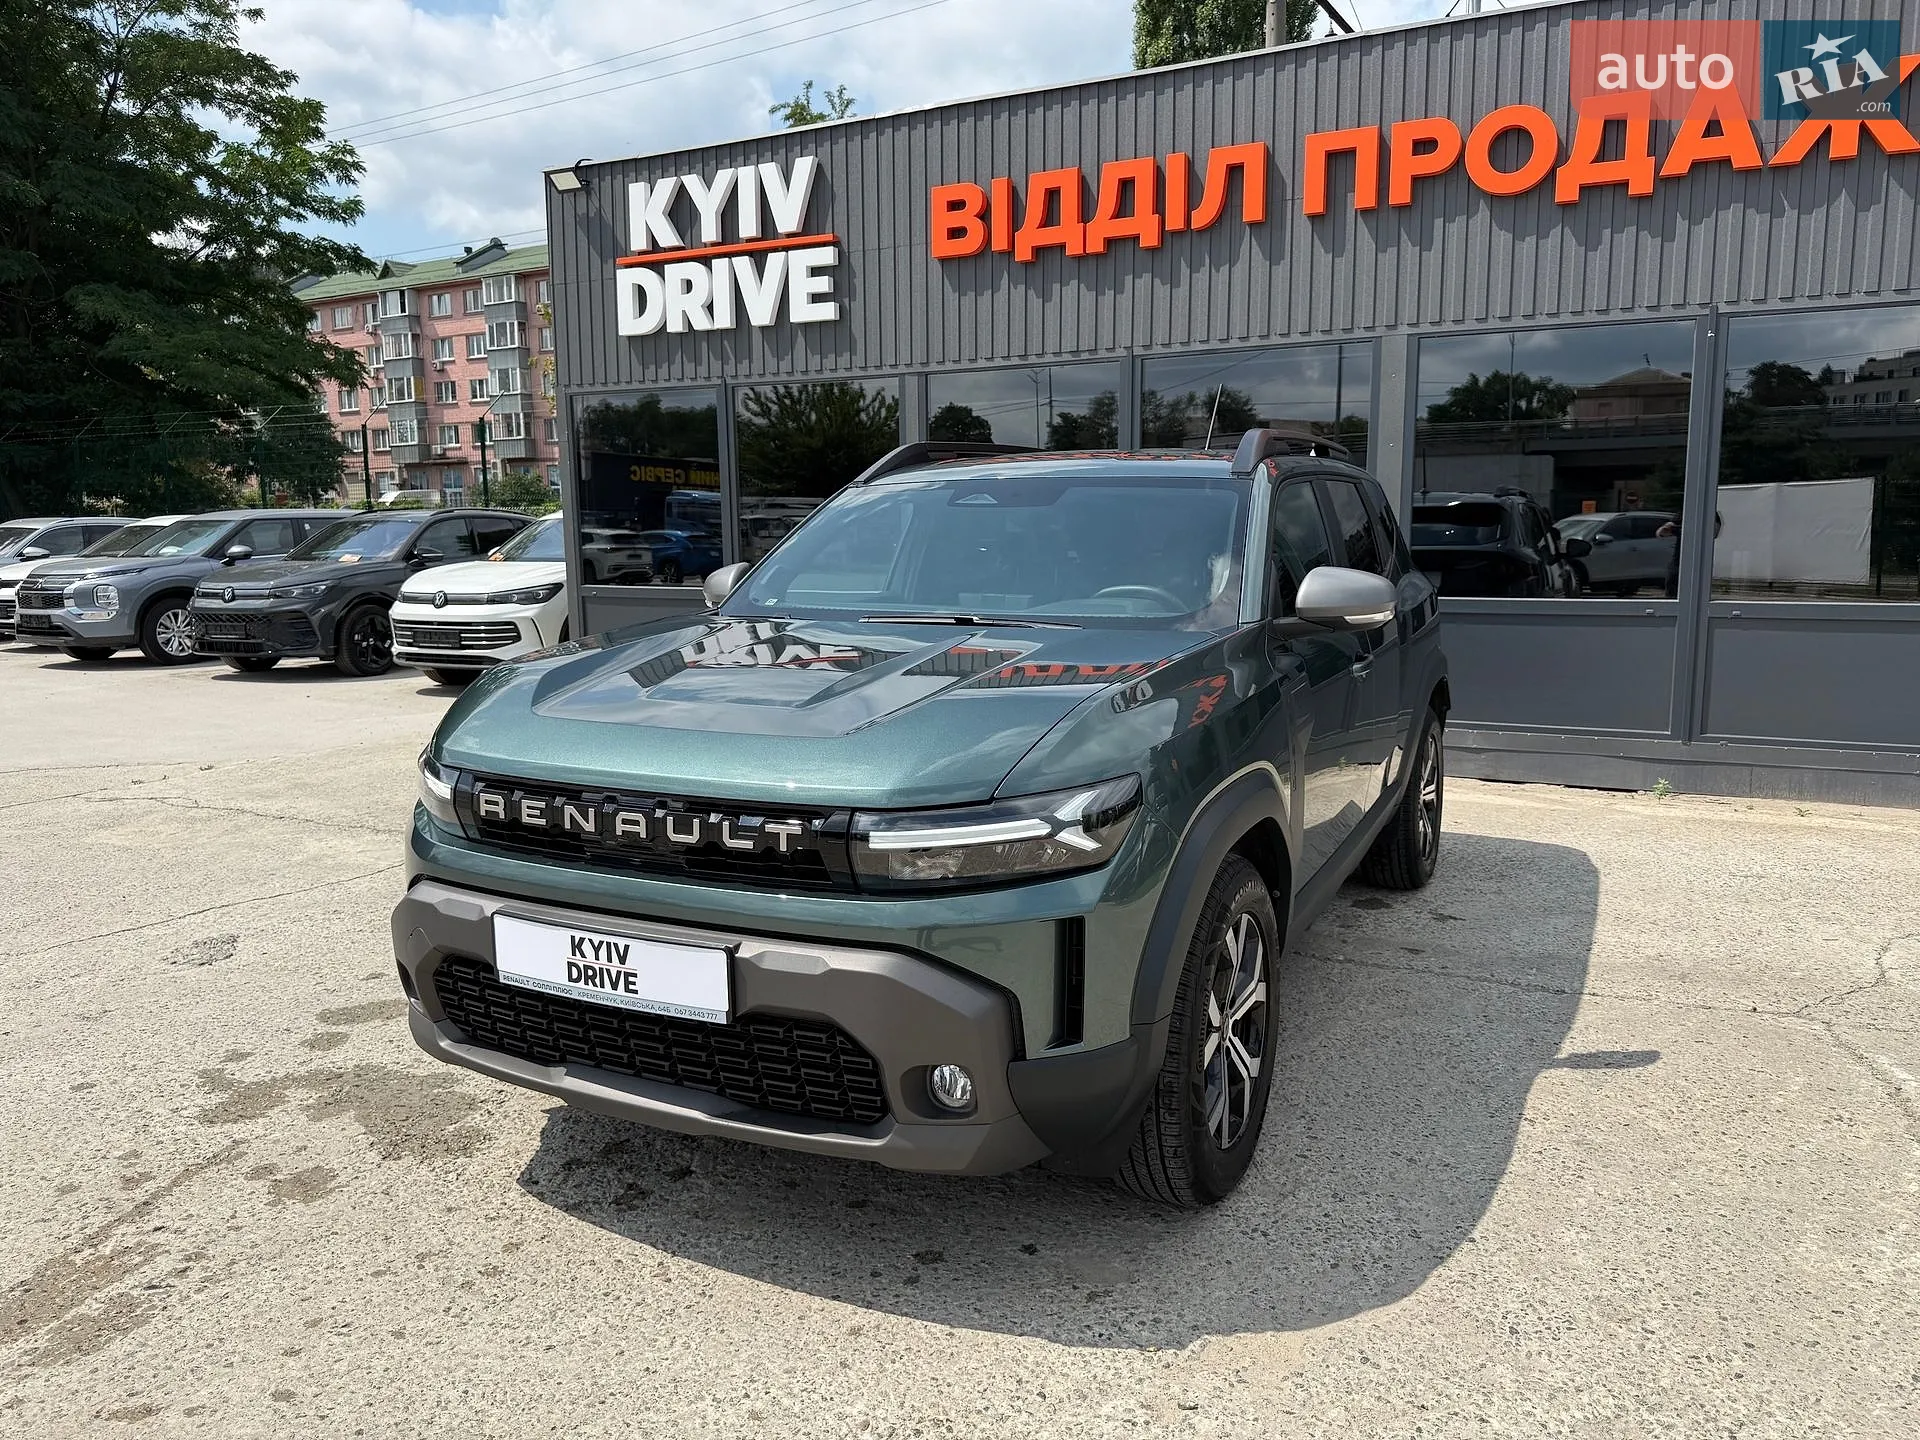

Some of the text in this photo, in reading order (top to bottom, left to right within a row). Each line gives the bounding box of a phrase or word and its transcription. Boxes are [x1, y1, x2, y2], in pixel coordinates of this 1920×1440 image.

[628, 155, 819, 253] KYIV
[931, 141, 1268, 263] ВІДДІЛ
[616, 245, 839, 336] DRIVE
[479, 792, 802, 852] RENAULT
[566, 961, 639, 995] DRIVE
[570, 934, 630, 965] KYIV
[502, 974, 530, 986] RENAULT
